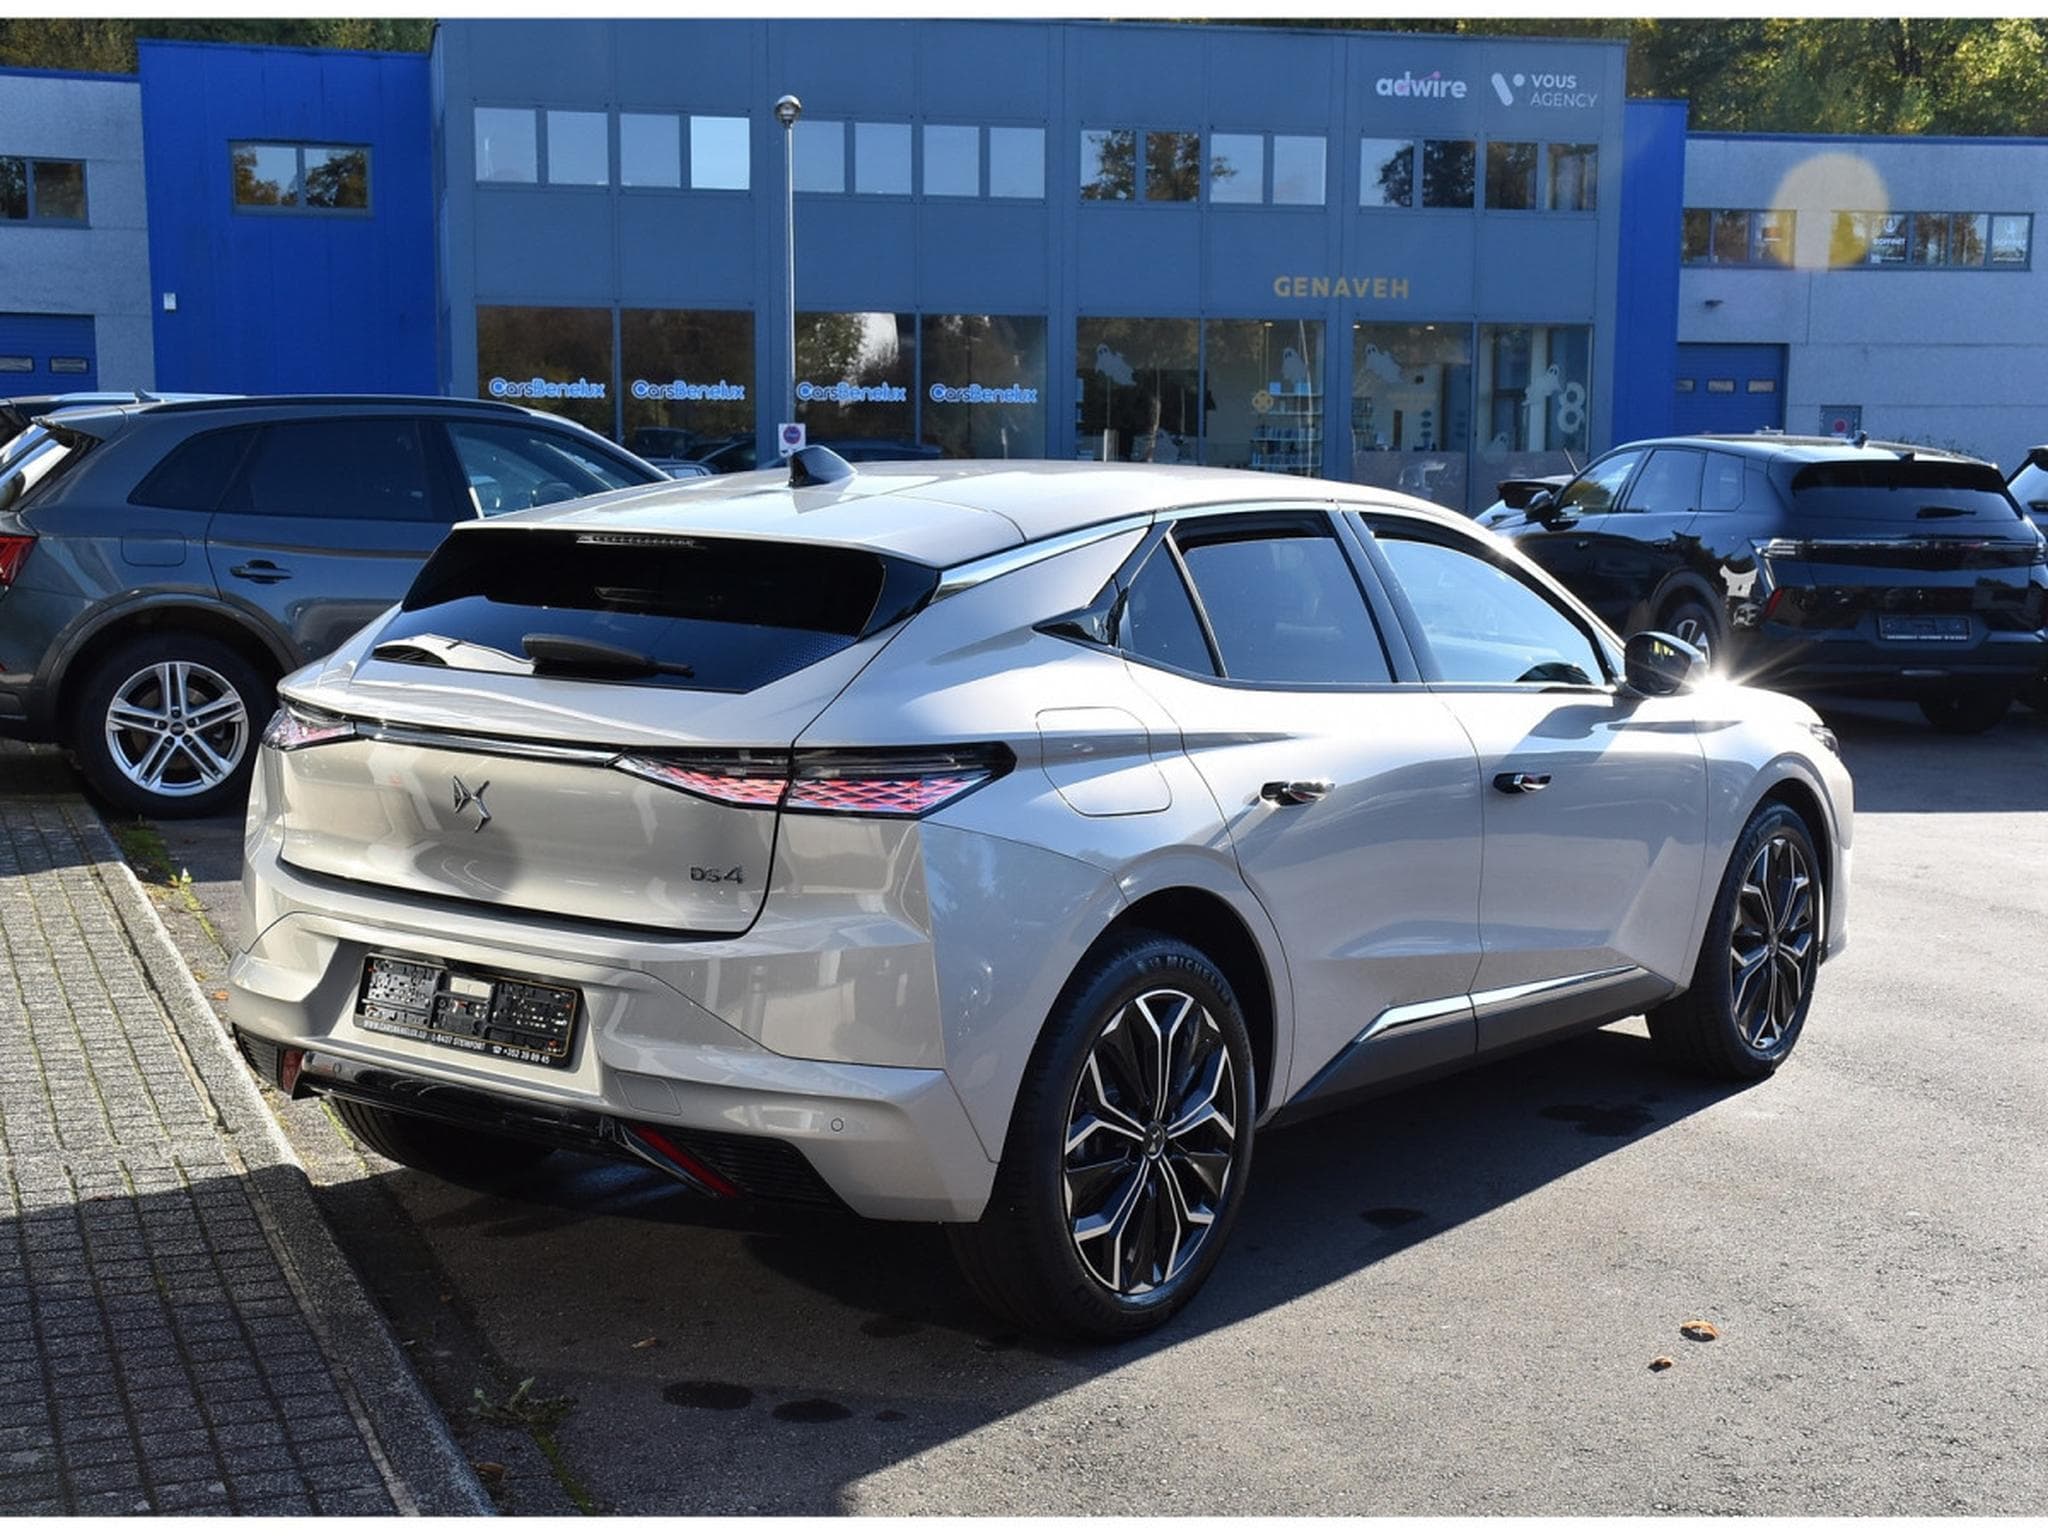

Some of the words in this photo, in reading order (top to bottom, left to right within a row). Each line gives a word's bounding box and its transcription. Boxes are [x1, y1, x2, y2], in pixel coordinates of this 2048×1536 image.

[1375, 71, 1467, 98] adwire
[1531, 74, 1577, 89] VOUS
[1530, 92, 1597, 107] AGENCY
[1274, 276, 1409, 299] GENAVEH
[489, 377, 605, 398] CarsBenelux
[631, 379, 745, 400] CarsBenelux
[796, 381, 907, 402] CarsBenelux
[929, 383, 1038, 403] CarsBenelux
